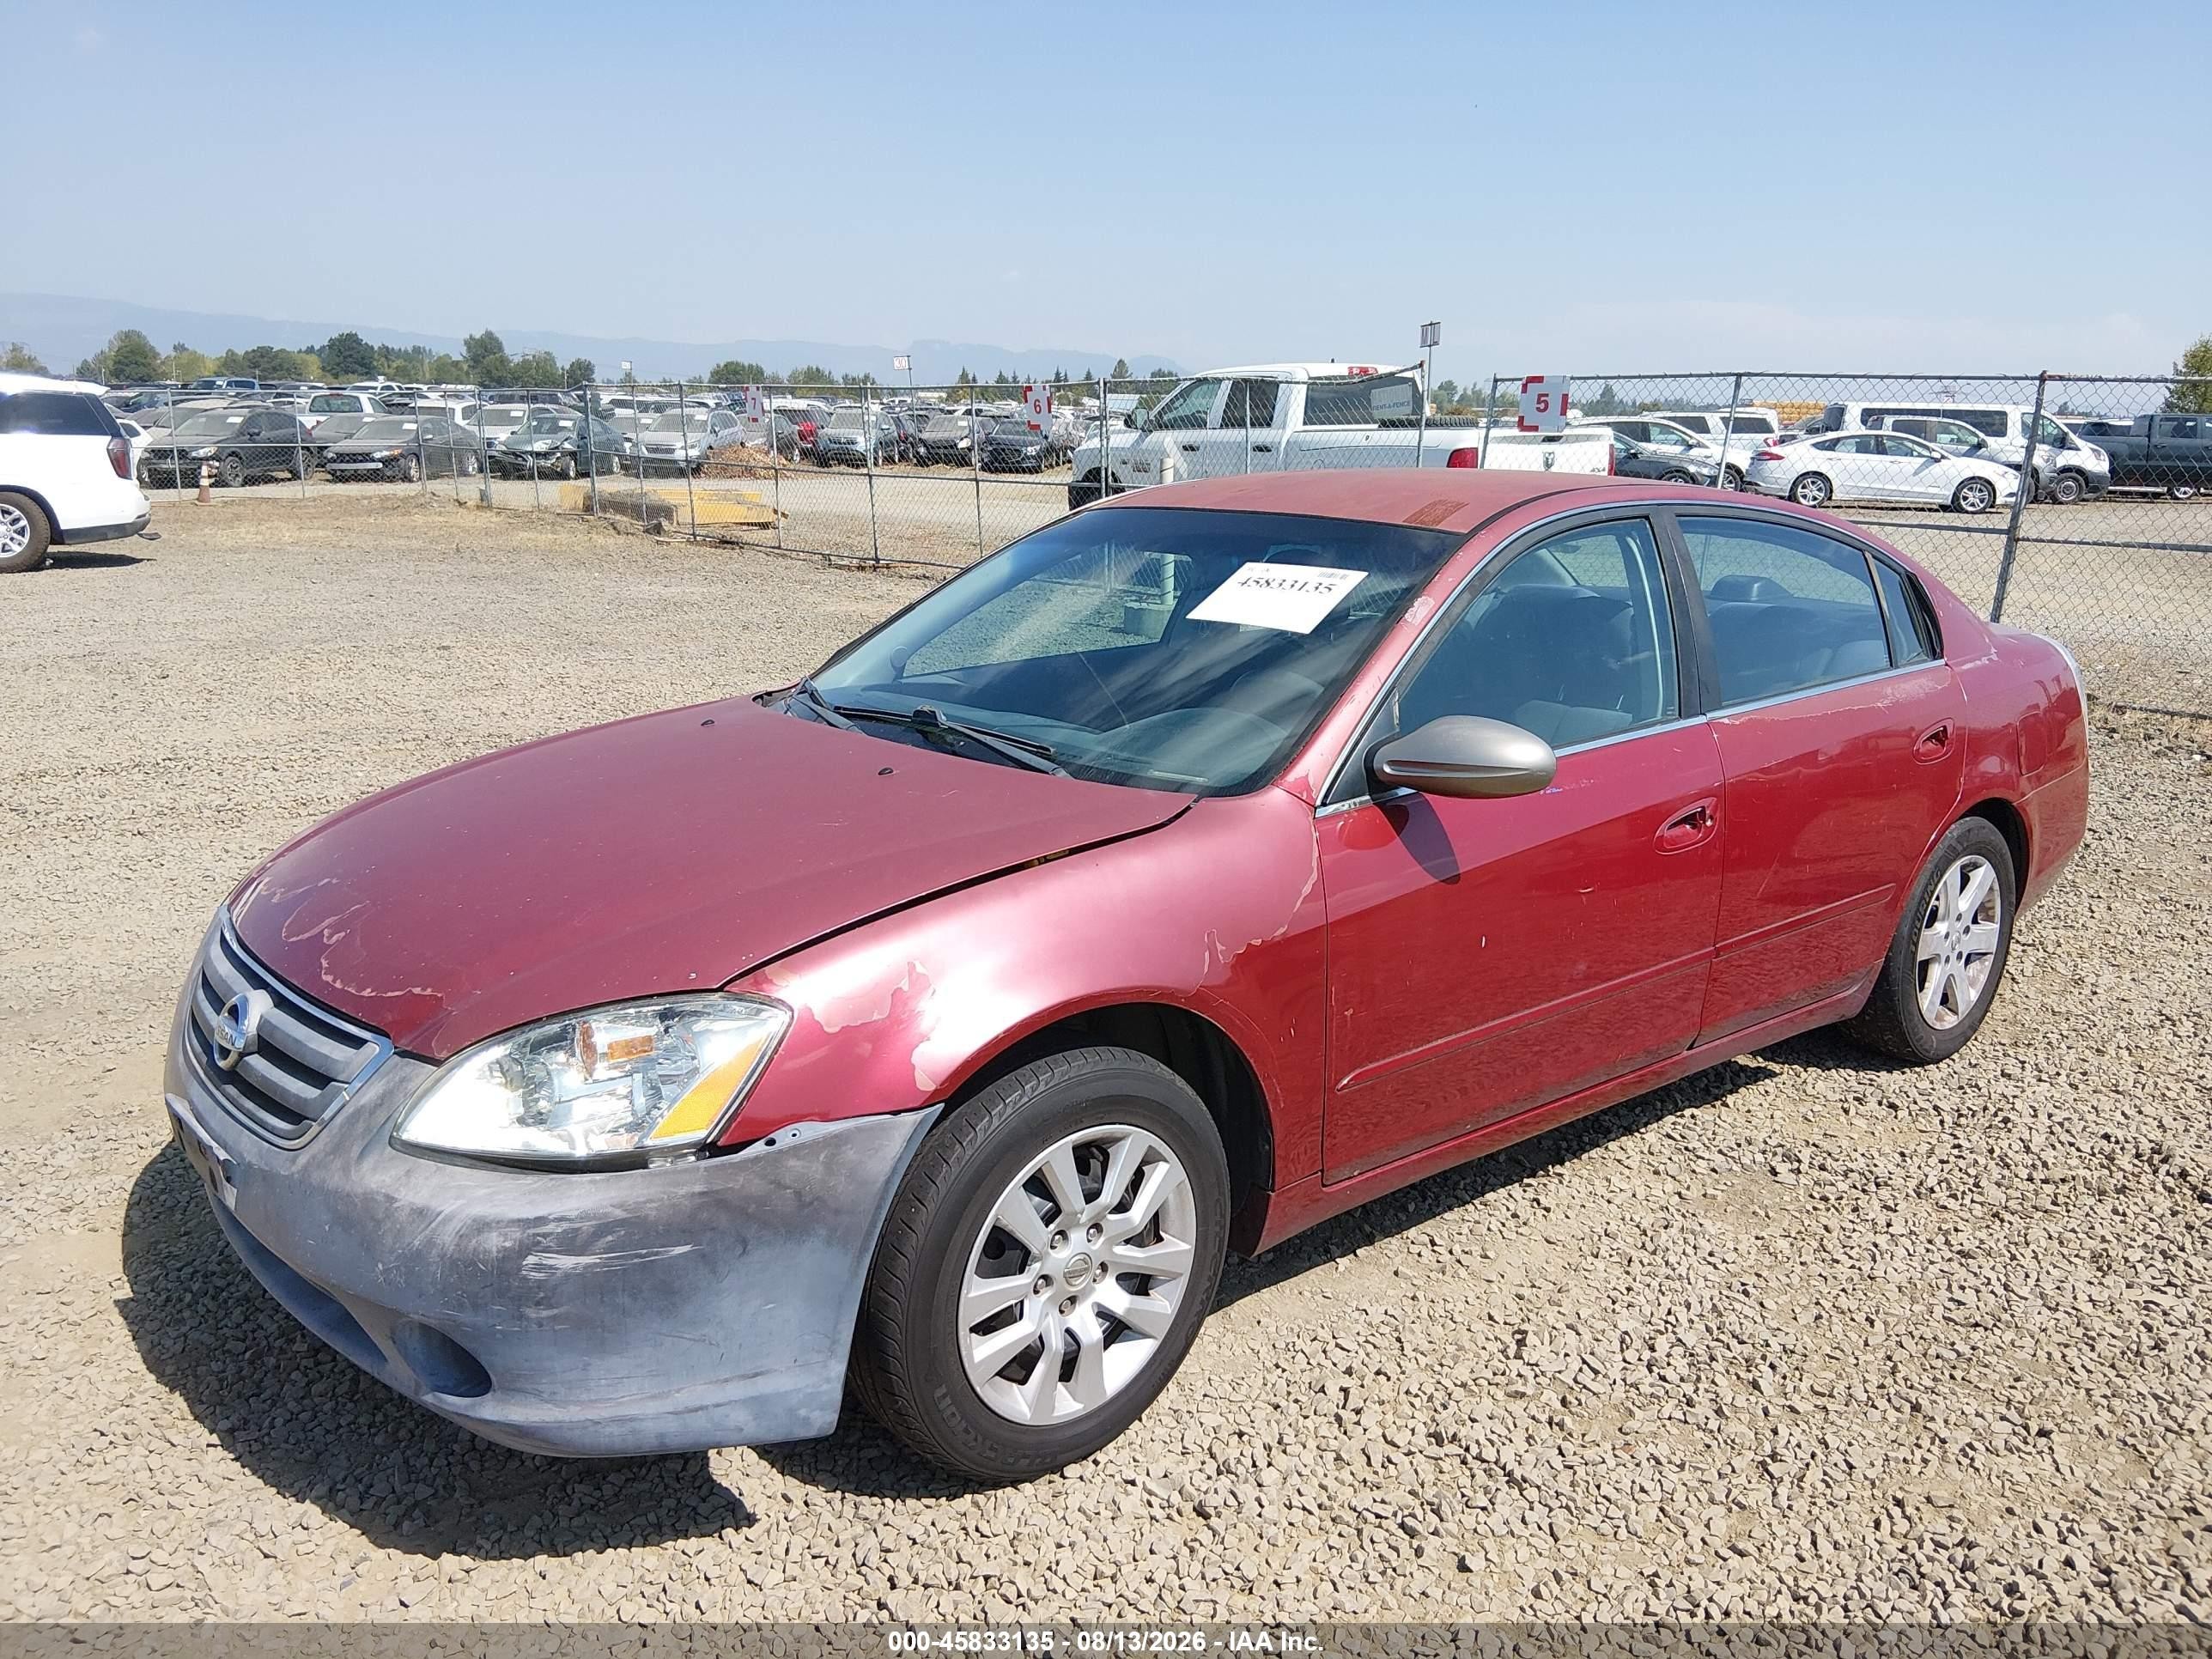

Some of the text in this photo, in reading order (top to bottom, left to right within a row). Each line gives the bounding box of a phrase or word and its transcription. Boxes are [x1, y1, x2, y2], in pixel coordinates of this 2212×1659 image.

[751, 397, 757, 410] 7
[1033, 398, 1042, 415] 6
[1535, 392, 1549, 413] 5
[1237, 576, 1340, 594] 45833135
